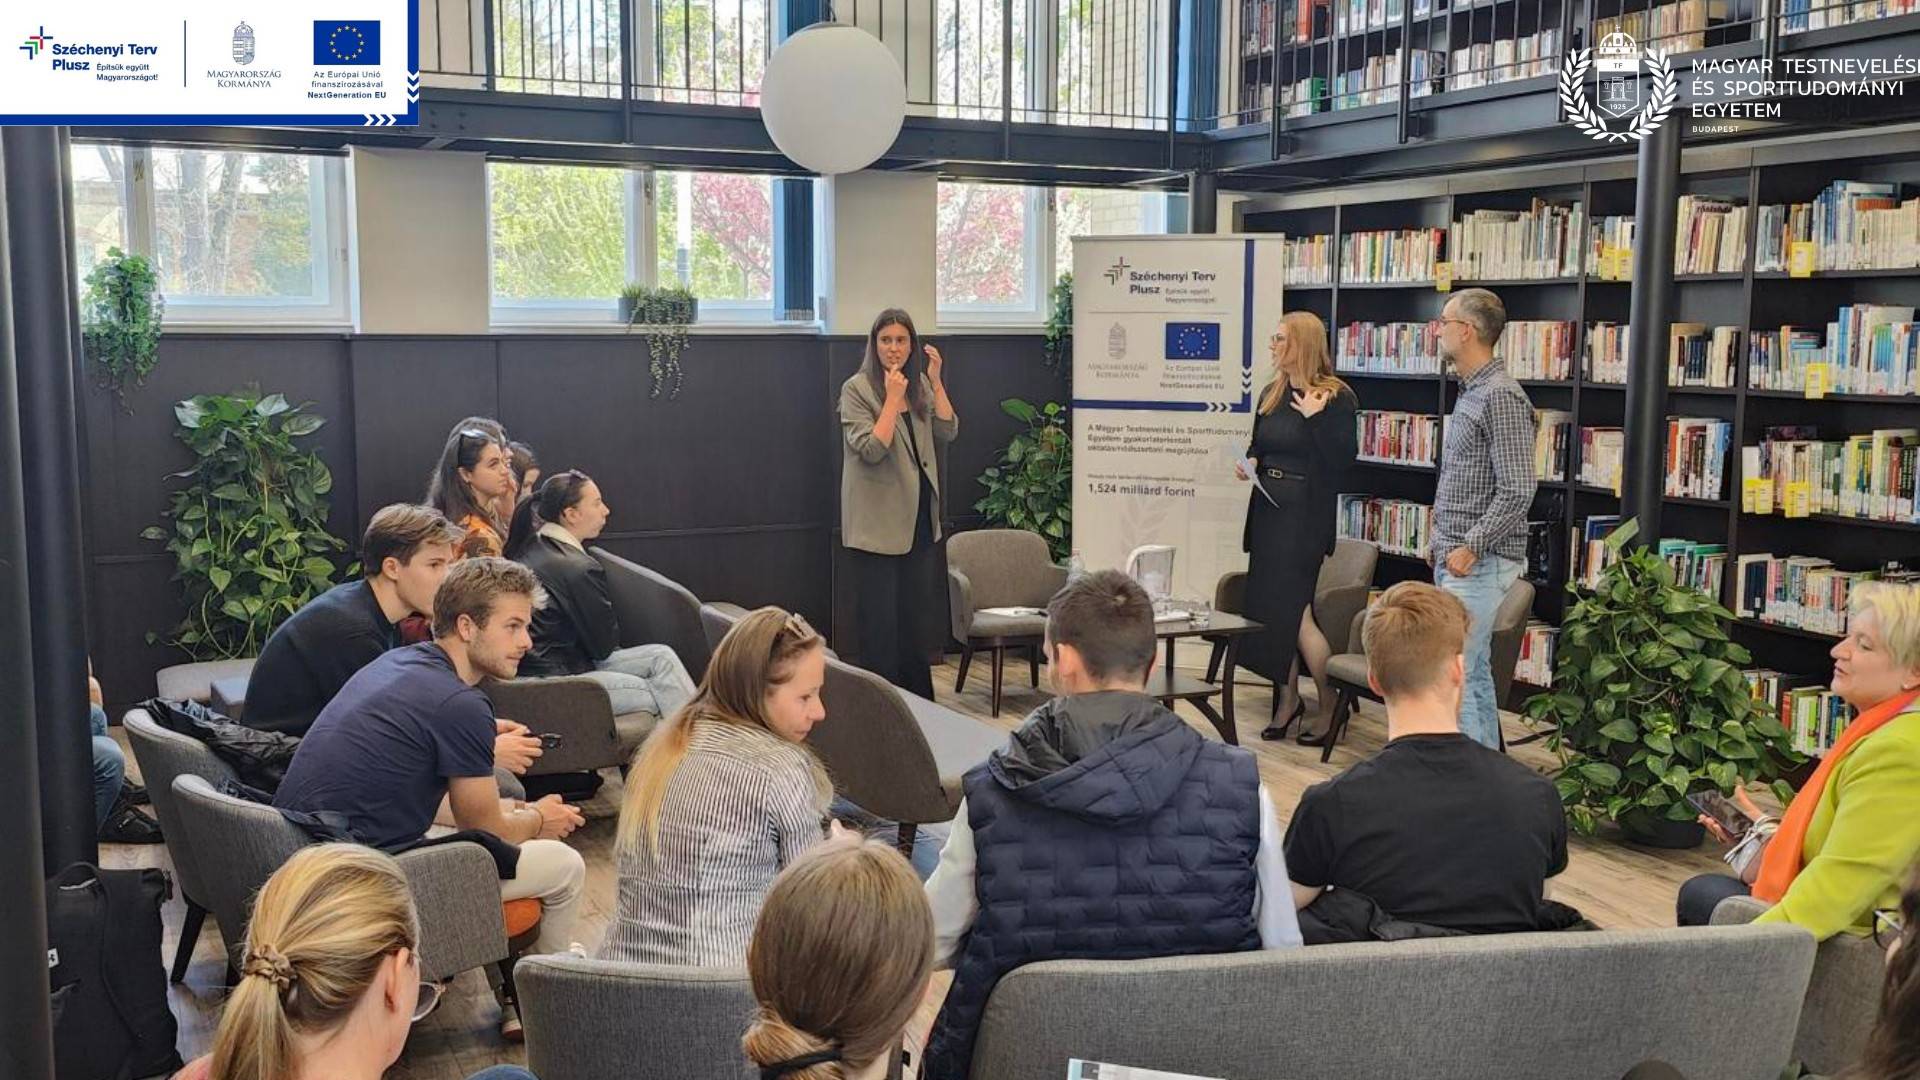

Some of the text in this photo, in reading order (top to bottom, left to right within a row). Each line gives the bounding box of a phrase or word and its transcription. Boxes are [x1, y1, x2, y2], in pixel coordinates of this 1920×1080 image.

[1192, 271, 1216, 281] Terv
[1130, 284, 1160, 294] Plusz
[1088, 483, 1195, 497] 1,524 milliárd forint
